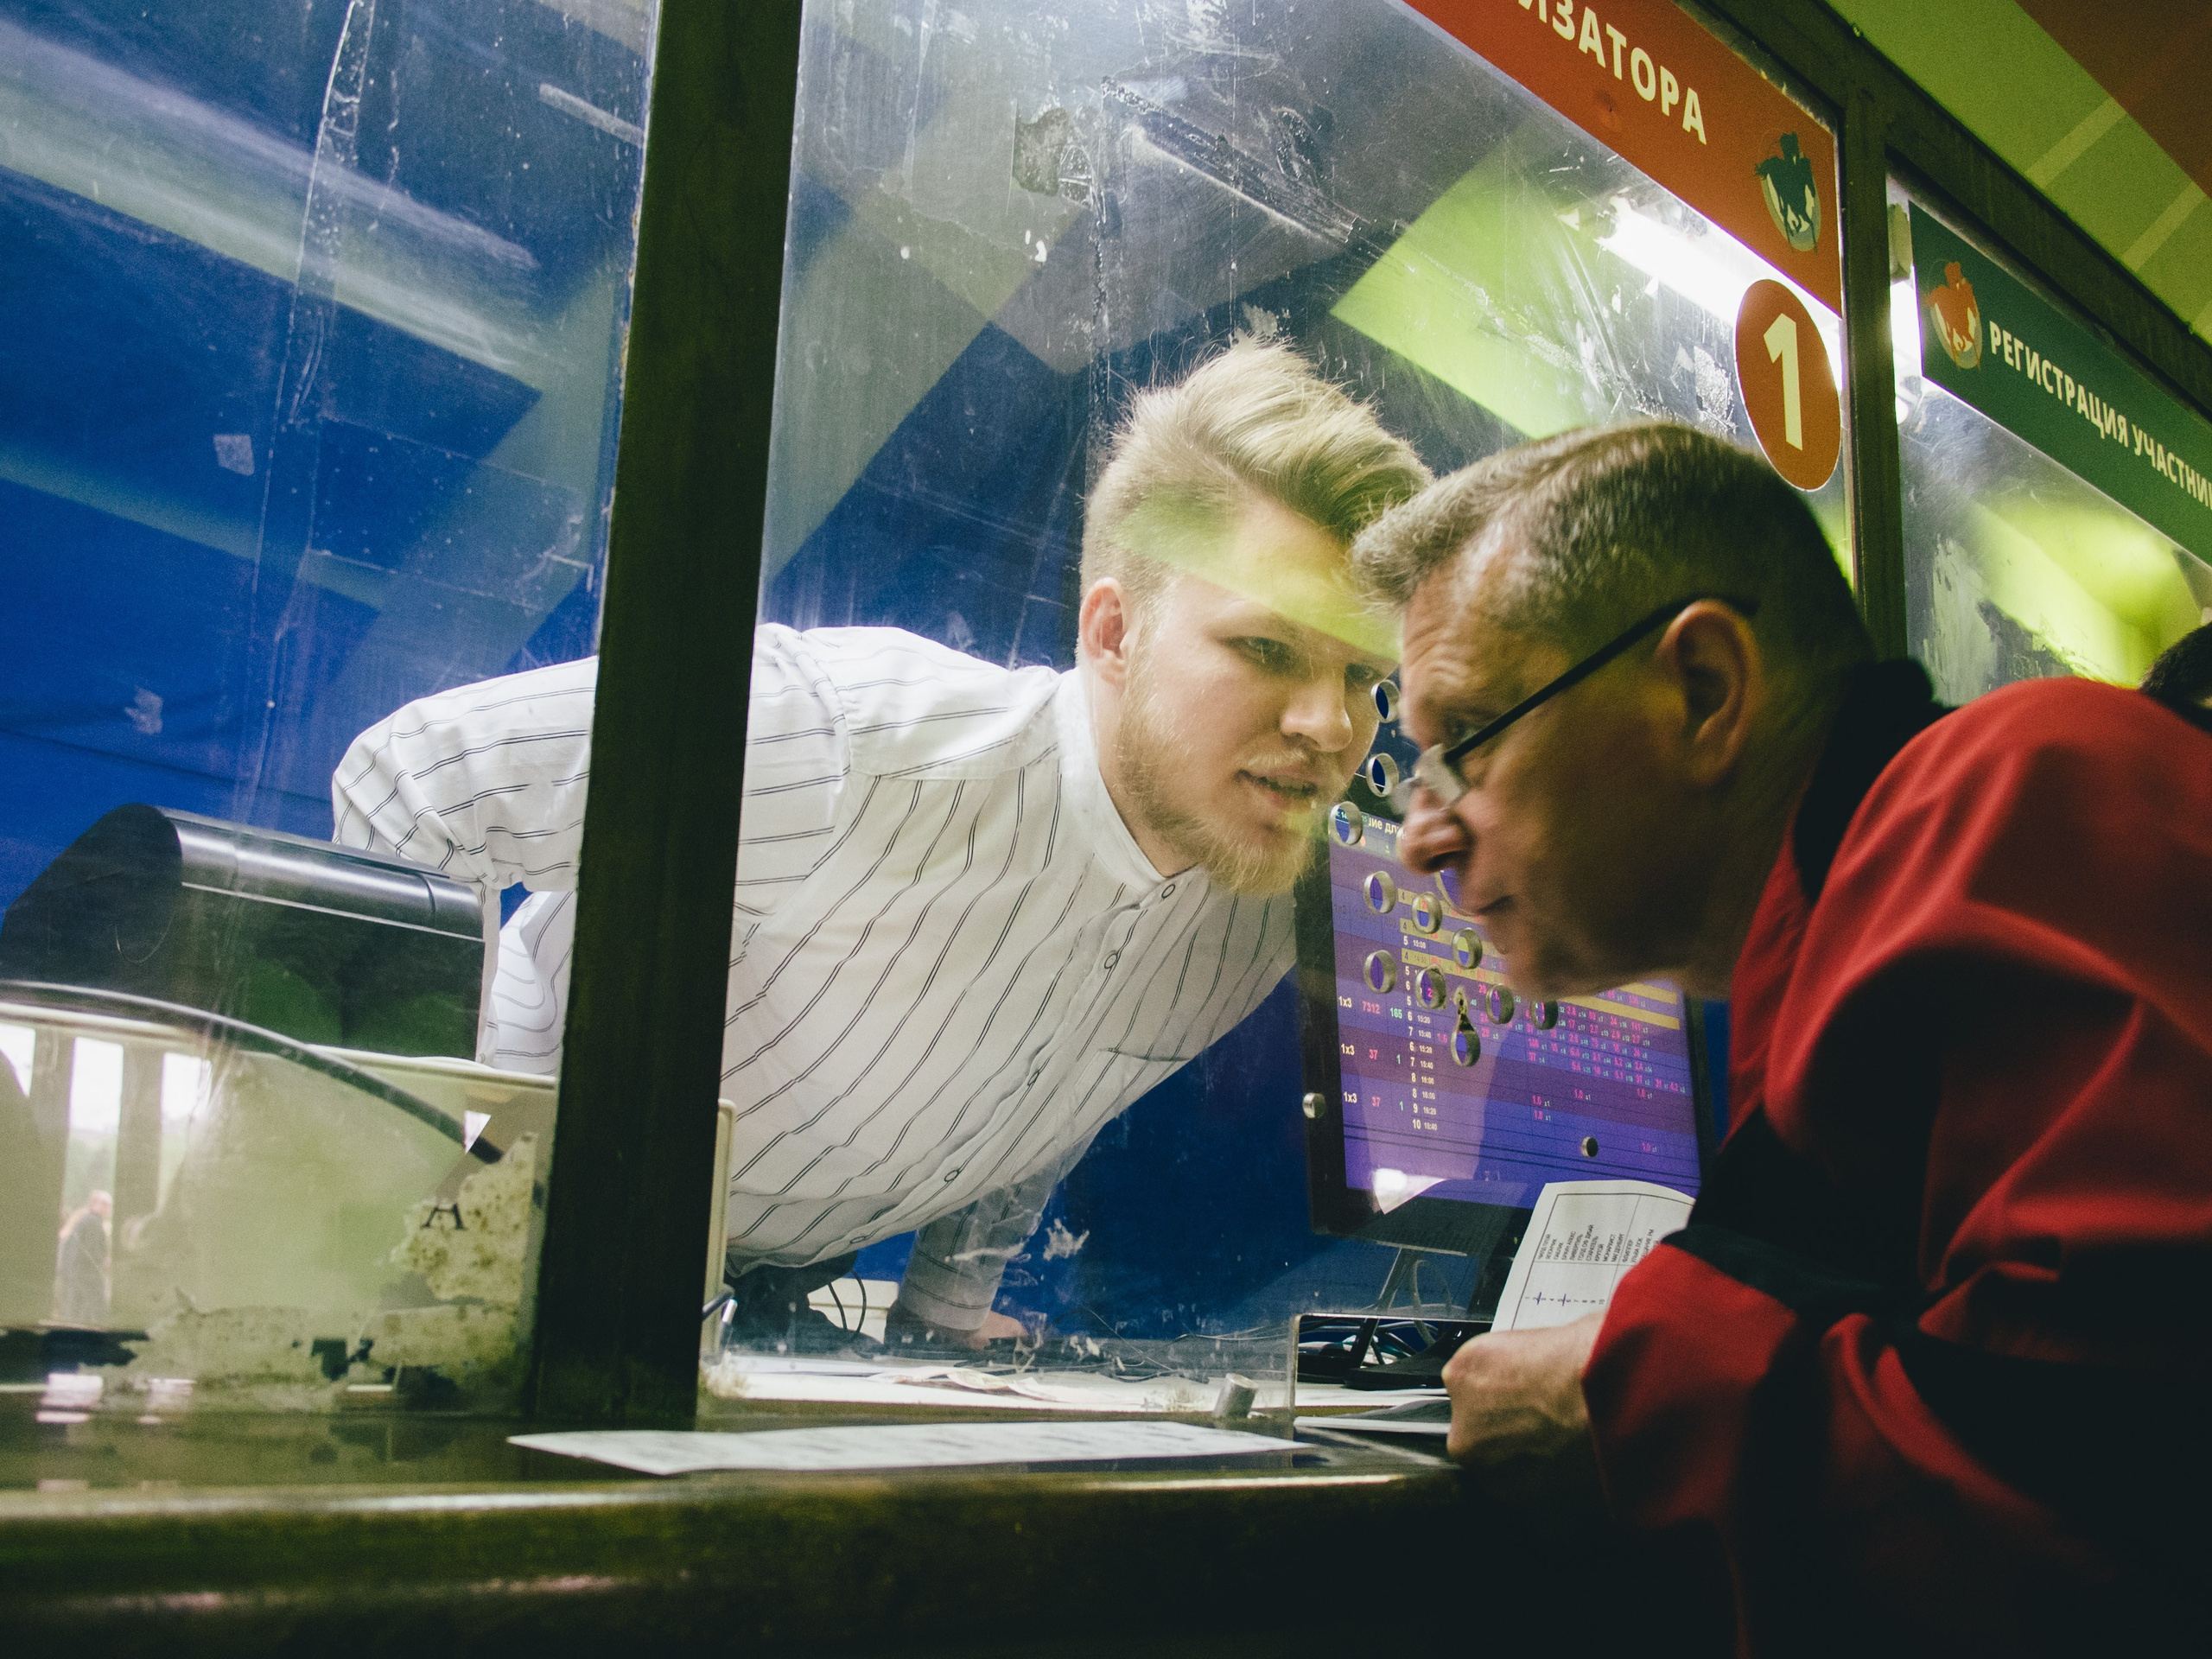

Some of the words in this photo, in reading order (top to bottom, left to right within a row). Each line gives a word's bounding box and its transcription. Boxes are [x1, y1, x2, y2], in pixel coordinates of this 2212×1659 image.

[1764, 313, 1802, 450] 1
[1989, 320, 2129, 448] РЕГИСТРАЦИЯ
[1403, 936, 1408, 945] 5
[1405, 966, 1410, 976] 5
[1406, 981, 1411, 991] 6
[1338, 995, 1352, 1008] 1x3
[1407, 995, 1412, 1006] 5
[1389, 1007, 1403, 1019] 165
[1408, 1011, 1413, 1021] 6
[1408, 1027, 1414, 1037] 7
[1409, 1041, 1414, 1052] 6
[1341, 1043, 1355, 1055] 1x3
[1369, 1049, 1378, 1060] 37
[1396, 1054, 1401, 1065] 1
[1410, 1057, 1415, 1067] 7
[1411, 1072, 1416, 1083] 8
[1412, 1088, 1417, 1098] 8
[1344, 1091, 1357, 1103] 1x3
[1371, 1096, 1381, 1107] 37
[1400, 1101, 1404, 1111] 1
[1413, 1103, 1418, 1113] 9
[1413, 1118, 1421, 1129] 10
